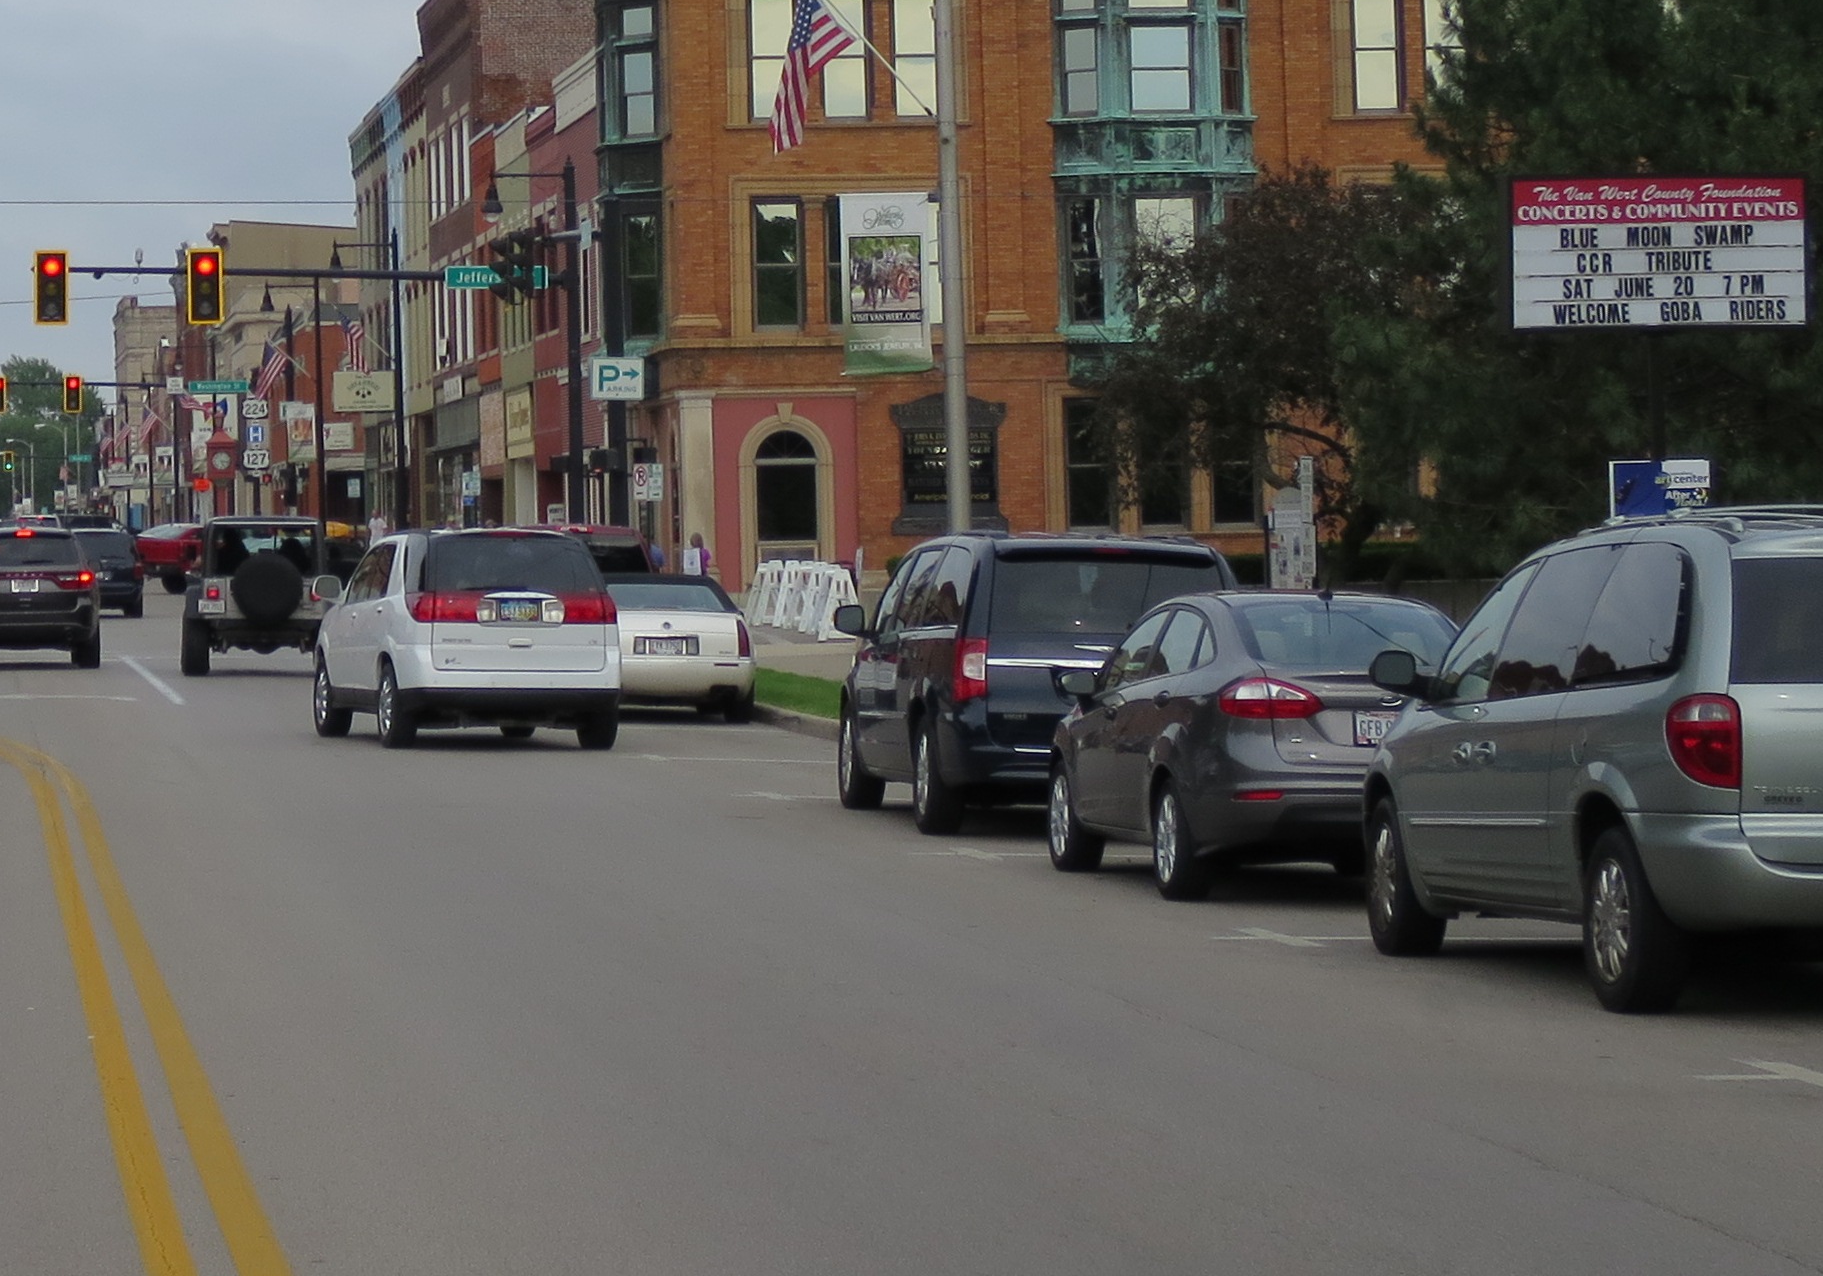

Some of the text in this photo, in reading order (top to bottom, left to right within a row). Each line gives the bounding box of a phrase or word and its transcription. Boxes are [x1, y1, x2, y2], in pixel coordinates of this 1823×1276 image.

[1533, 183, 1782, 202] The Van Wert County Foundation
[1517, 201, 1799, 221] CONCERTS & COMMUNITY EVENTS
[1560, 224, 1754, 248] BLUE MOON SWAMP
[1576, 251, 1713, 273] CCR TRIBUTE
[456, 272, 502, 284] Jeffers
[1562, 275, 1765, 299] SAT JUNE 20 7 PM
[1553, 300, 1787, 324] WELCOME GOBA RIDERS
[245, 404, 265, 416] 224
[246, 453, 266, 466] 127
[1673, 475, 1709, 484] center
